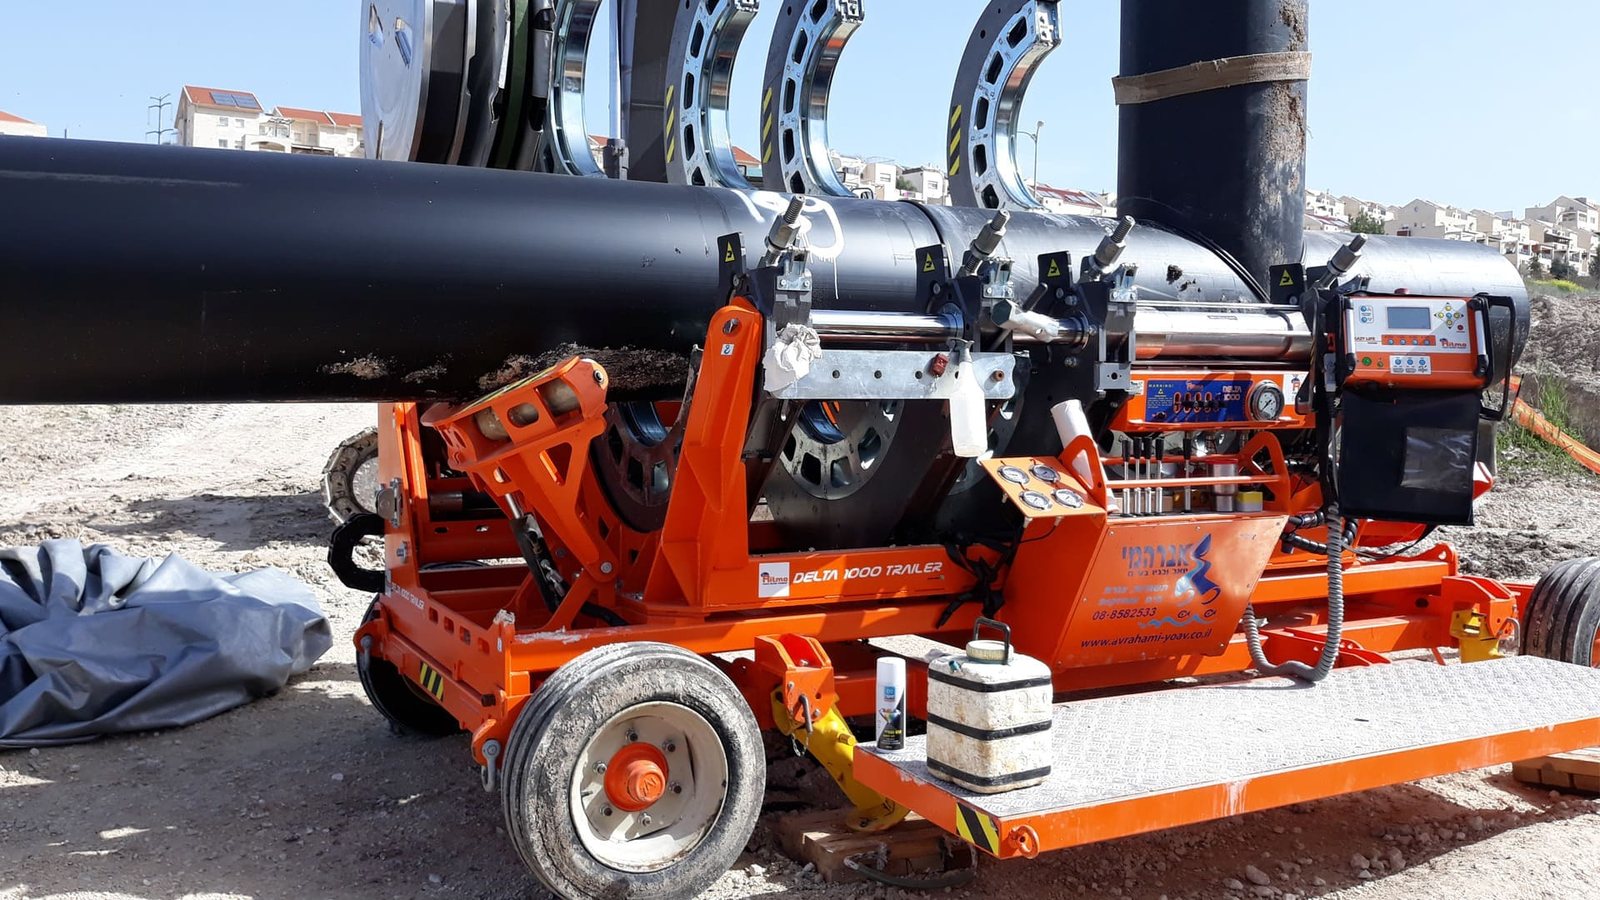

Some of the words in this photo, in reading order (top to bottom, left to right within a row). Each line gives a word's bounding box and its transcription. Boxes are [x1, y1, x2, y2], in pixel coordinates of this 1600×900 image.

[1222, 385, 1242, 393] DELTA
[1223, 393, 1240, 401] 1000
[761, 572, 788, 583] Ritmo
[793, 569, 838, 584] DELTA
[843, 566, 882, 580] 1000
[886, 562, 943, 576] TRAILER
[1080, 629, 1212, 648] www.avrahami-yoav.co.il
